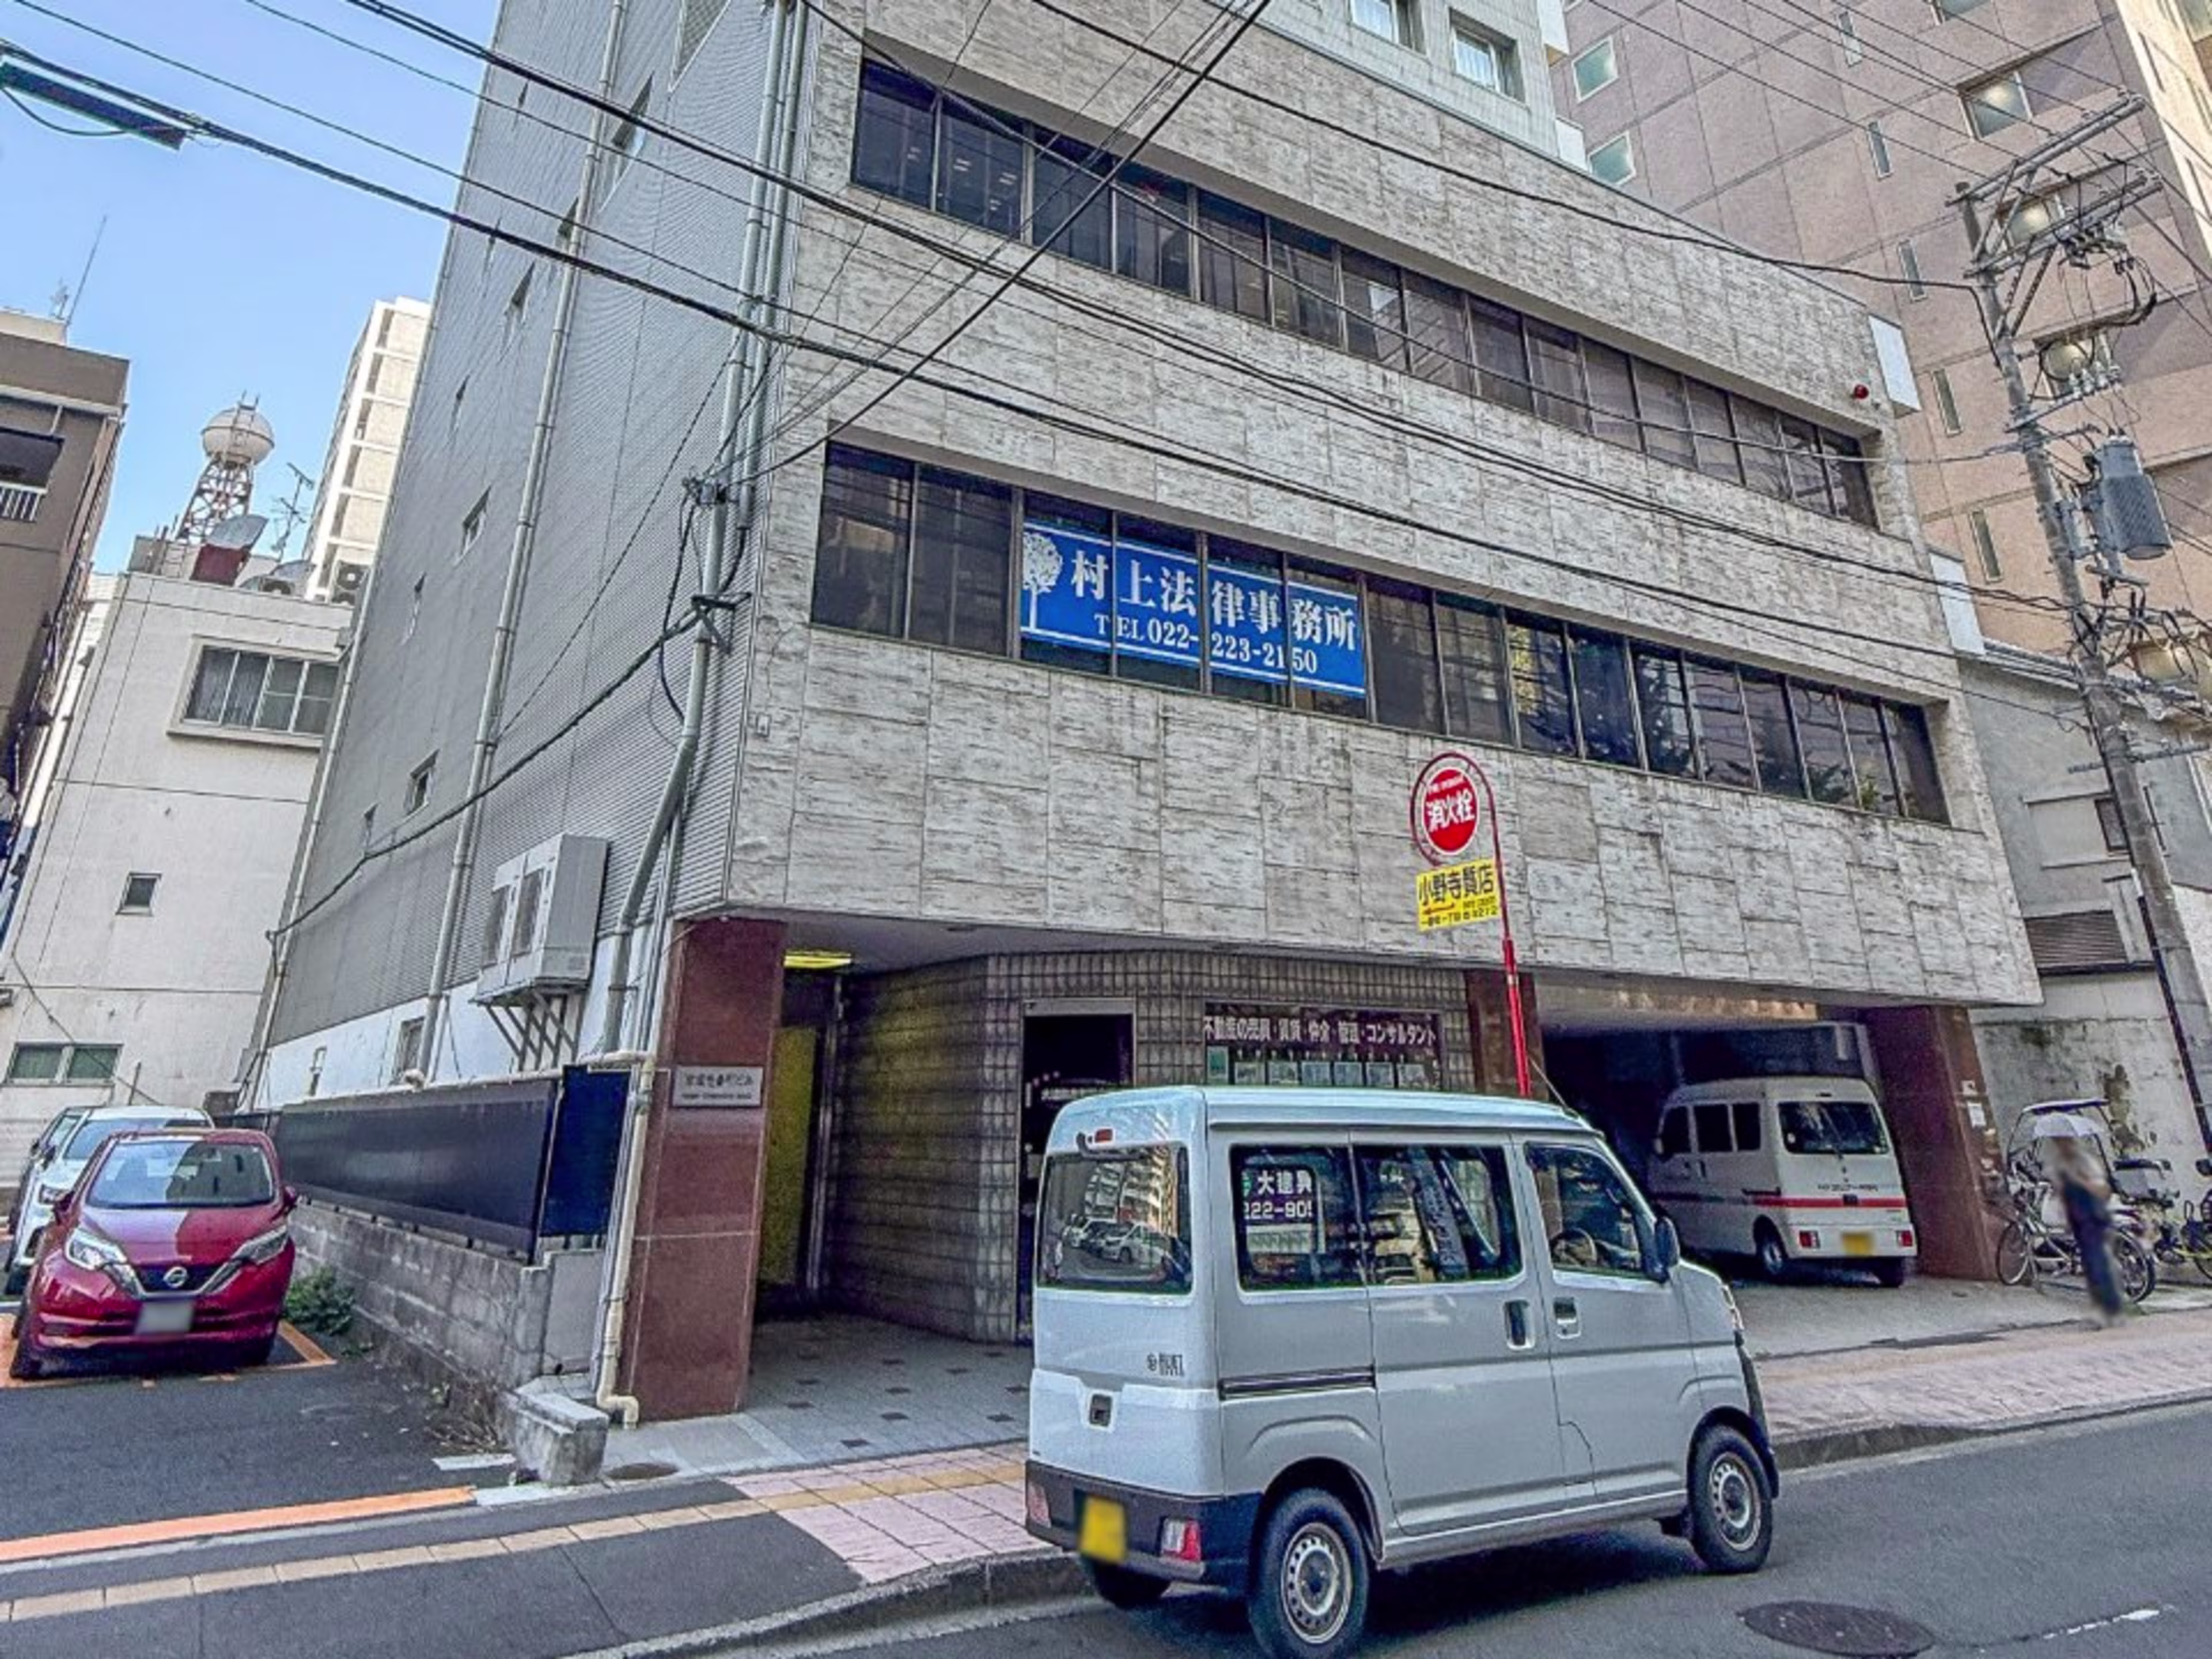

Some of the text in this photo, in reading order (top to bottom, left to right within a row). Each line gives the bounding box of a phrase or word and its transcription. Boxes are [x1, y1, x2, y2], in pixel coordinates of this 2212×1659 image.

[1070, 549, 1357, 651] 村上法律事務所
[1426, 788, 1475, 832] 消火栓
